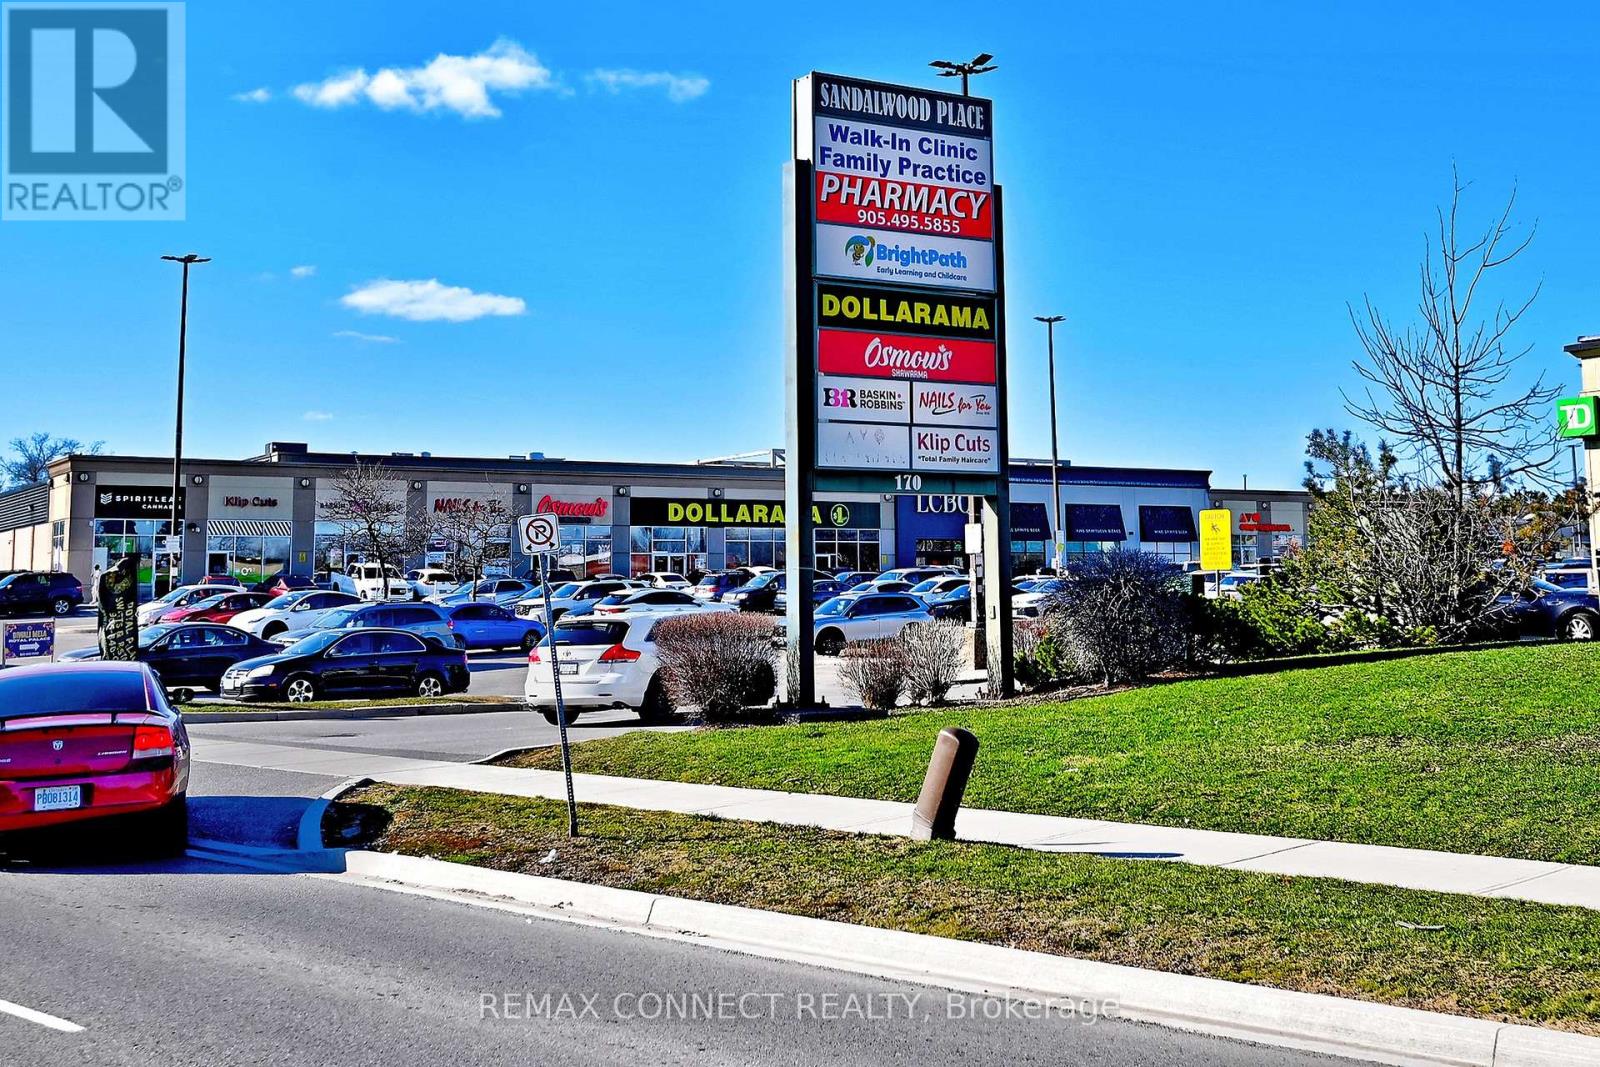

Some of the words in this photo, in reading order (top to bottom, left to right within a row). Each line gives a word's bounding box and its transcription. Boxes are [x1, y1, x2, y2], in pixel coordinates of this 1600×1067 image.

[820, 82, 931, 121] SANDALWOOD
[937, 100, 984, 130] PLACE
[829, 124, 911, 152] Walk-In
[918, 137, 978, 161] Clinic
[820, 146, 891, 178] Family
[899, 157, 986, 186] Practice
[820, 174, 988, 220] PHARMACY
[857, 210, 960, 234] 905.495.5855
[877, 244, 968, 269] BrightPath
[877, 266, 894, 276] Early
[895, 267, 923, 279] Learning
[937, 271, 968, 282] Childcare
[822, 294, 990, 330] DOLLARAMA
[823, 387, 858, 409] BR
[860, 390, 896, 401] BASKIN
[860, 400, 903, 411] ROBBINS
[919, 391, 954, 410] NAILS
[957, 397, 973, 414] for
[971, 394, 992, 412] You
[1559, 404, 1591, 430] TD
[917, 432, 951, 454] Klip
[955, 434, 991, 453] Cuts
[938, 456, 960, 465] Family
[894, 474, 922, 491] 170
[115, 495, 182, 503] SPIRITLEA
[225, 496, 250, 508] Klip
[252, 496, 278, 507] Cuts
[668, 503, 823, 525] DOLLARAA
